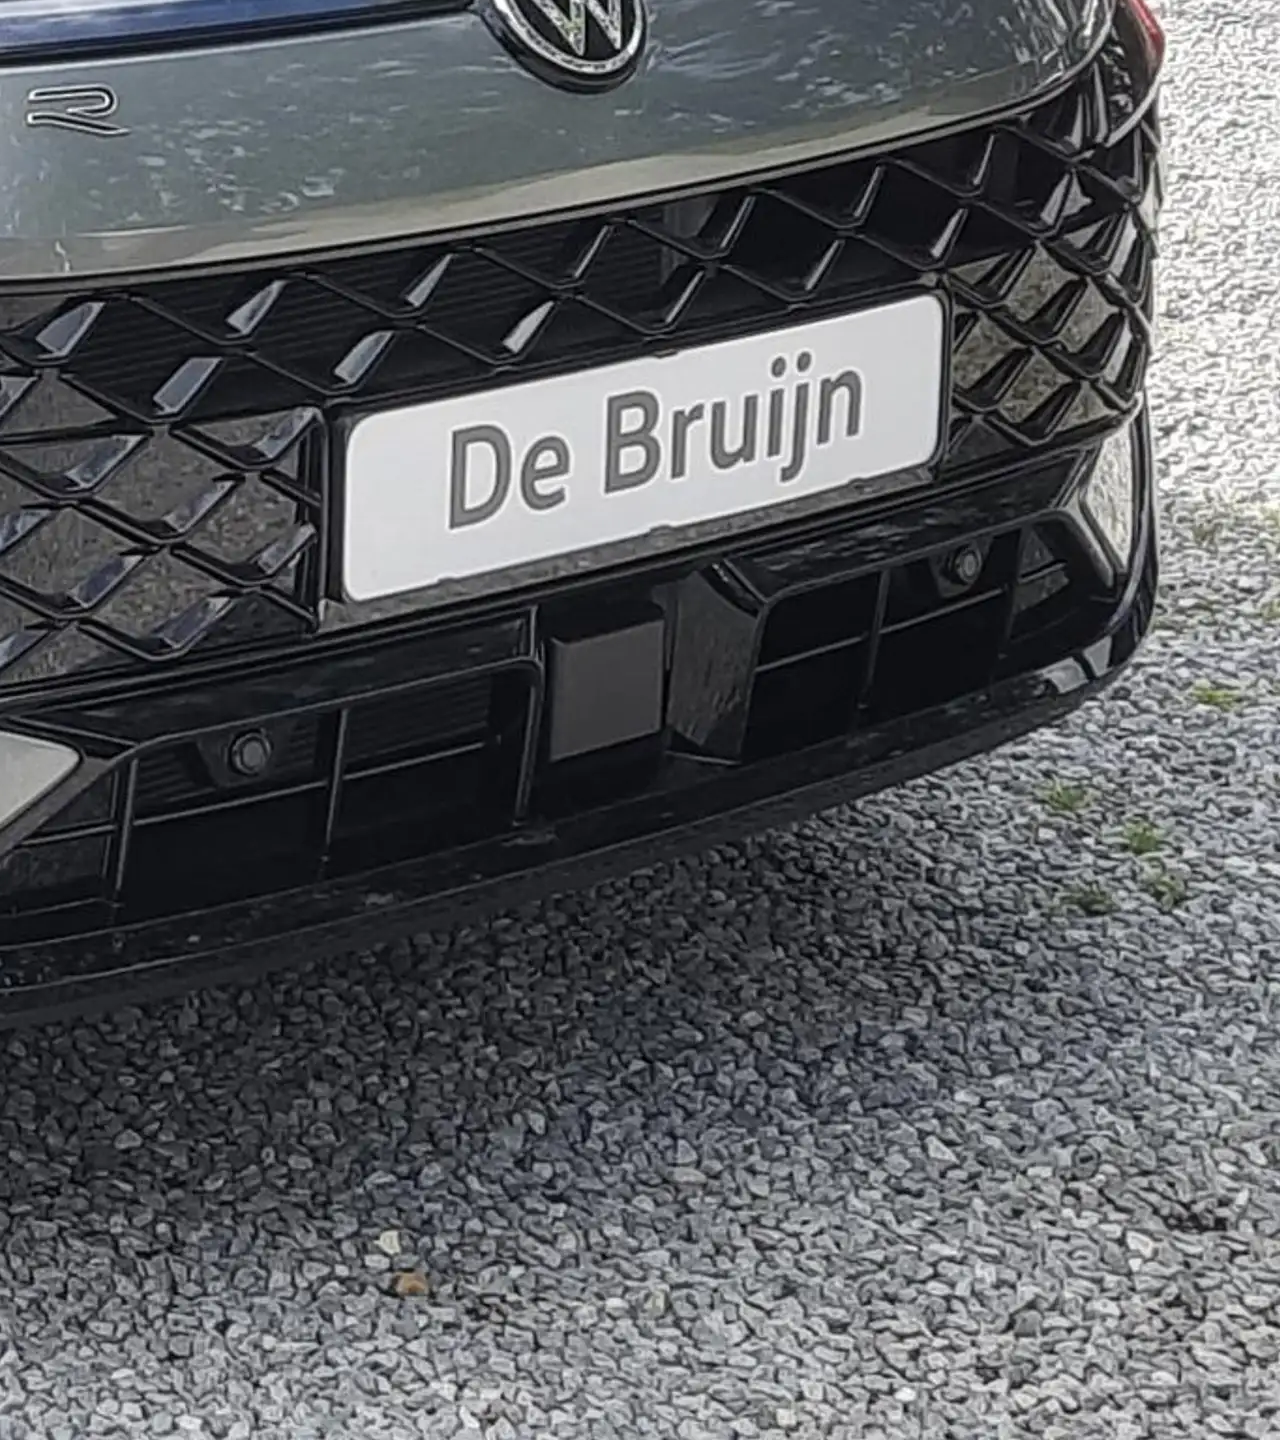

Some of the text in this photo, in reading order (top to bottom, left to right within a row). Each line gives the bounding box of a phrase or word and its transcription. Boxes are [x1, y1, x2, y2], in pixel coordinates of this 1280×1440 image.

[26, 82, 130, 137] R
[448, 351, 863, 530] De Bruijn
